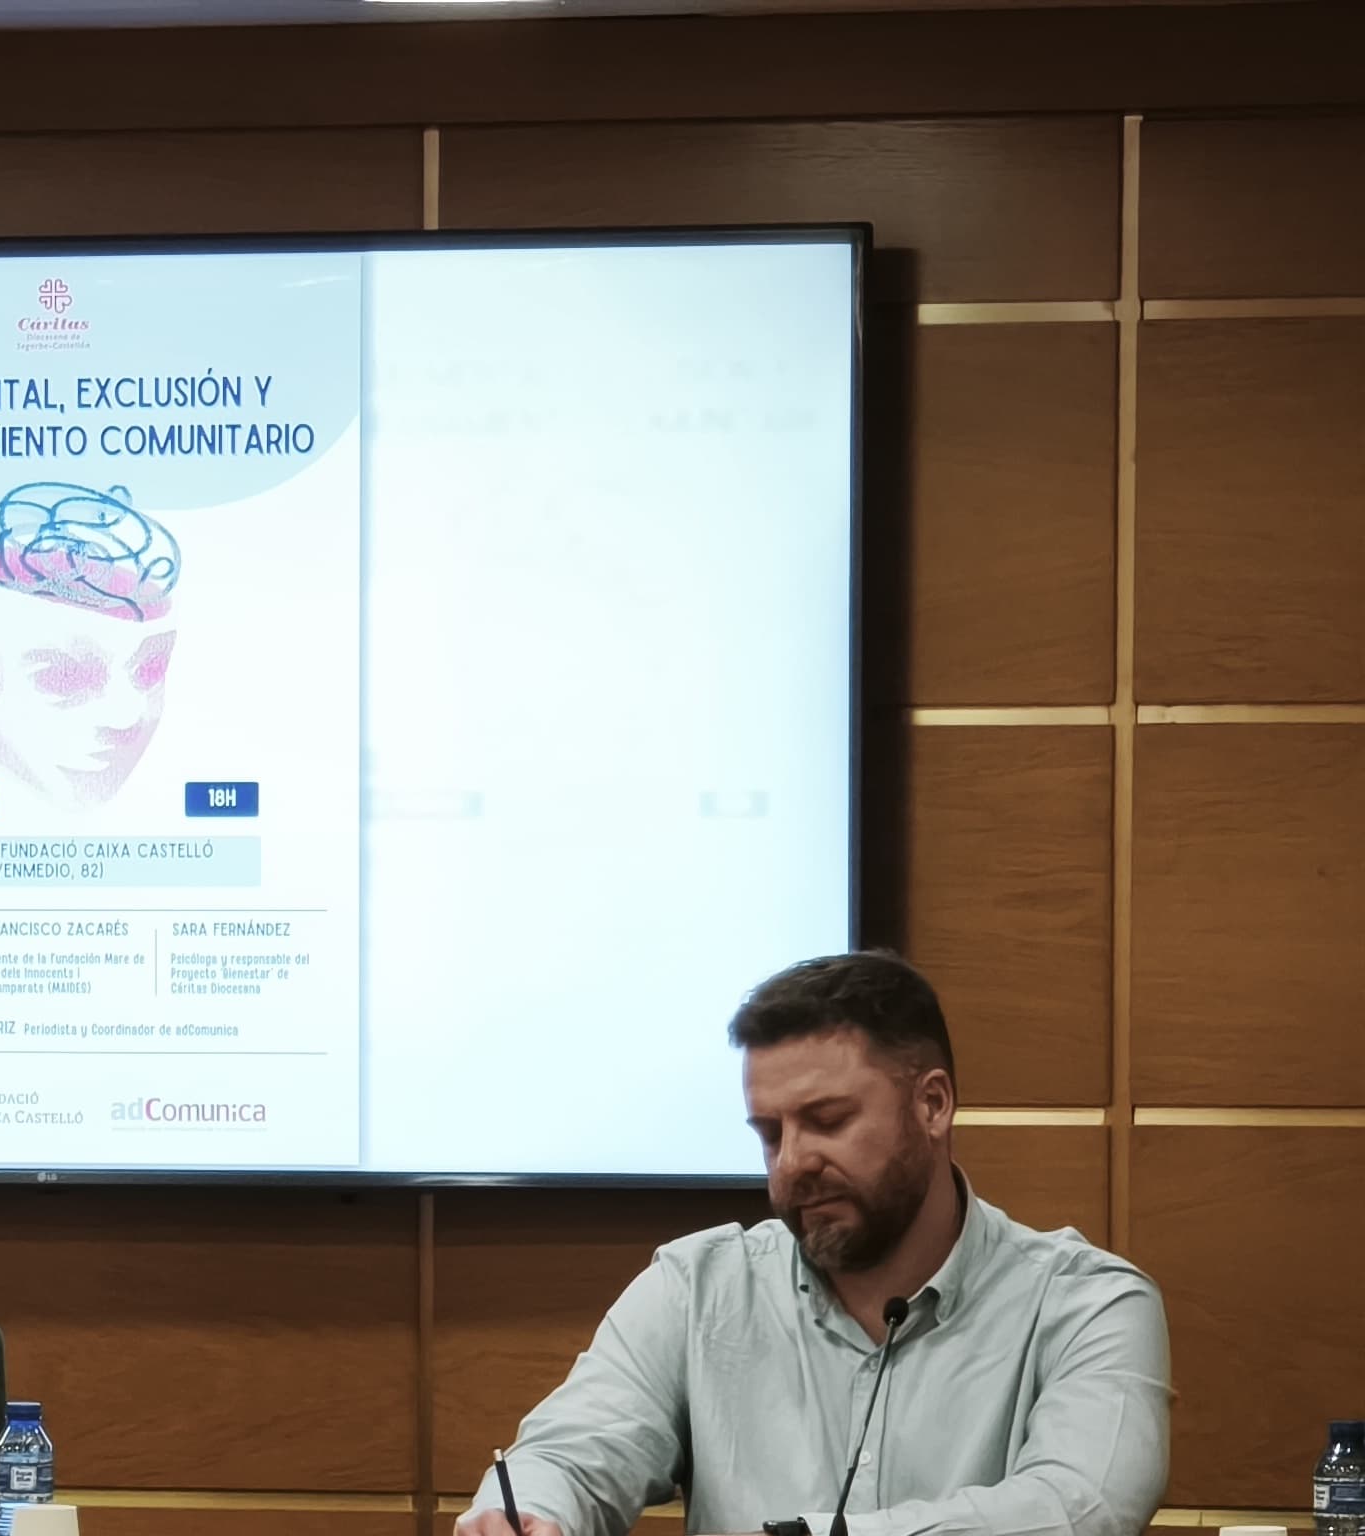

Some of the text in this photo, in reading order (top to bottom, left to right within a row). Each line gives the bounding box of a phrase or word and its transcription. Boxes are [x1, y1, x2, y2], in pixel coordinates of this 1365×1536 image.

[77, 368, 242, 409] EXCLUSIÓN
[254, 376, 272, 407] Y
[100, 423, 315, 456] COMUNITARIO
[208, 788, 237, 807] 18H
[1, 839, 77, 858] FUNDACIÓ
[84, 842, 131, 858] CAIXA
[137, 839, 214, 858] CASTELLÓ
[81, 862, 104, 879] 82)
[67, 919, 129, 936] ZACARÉS
[172, 918, 291, 936] SARA FERNÁNDEZ
[23, 952, 34, 965] de
[37, 952, 47, 965] la
[104, 952, 129, 965] Mare
[133, 952, 145, 965] de
[221, 955, 227, 967] y
[294, 953, 310, 965] del
[171, 967, 217, 981] Proyecto
[277, 967, 289, 980] de
[24, 1023, 77, 1036] Periodista
[81, 1025, 87, 1038] y
[91, 1023, 154, 1036] Coordinador
[159, 1023, 171, 1036] de
[111, 1097, 267, 1122] adComunica
